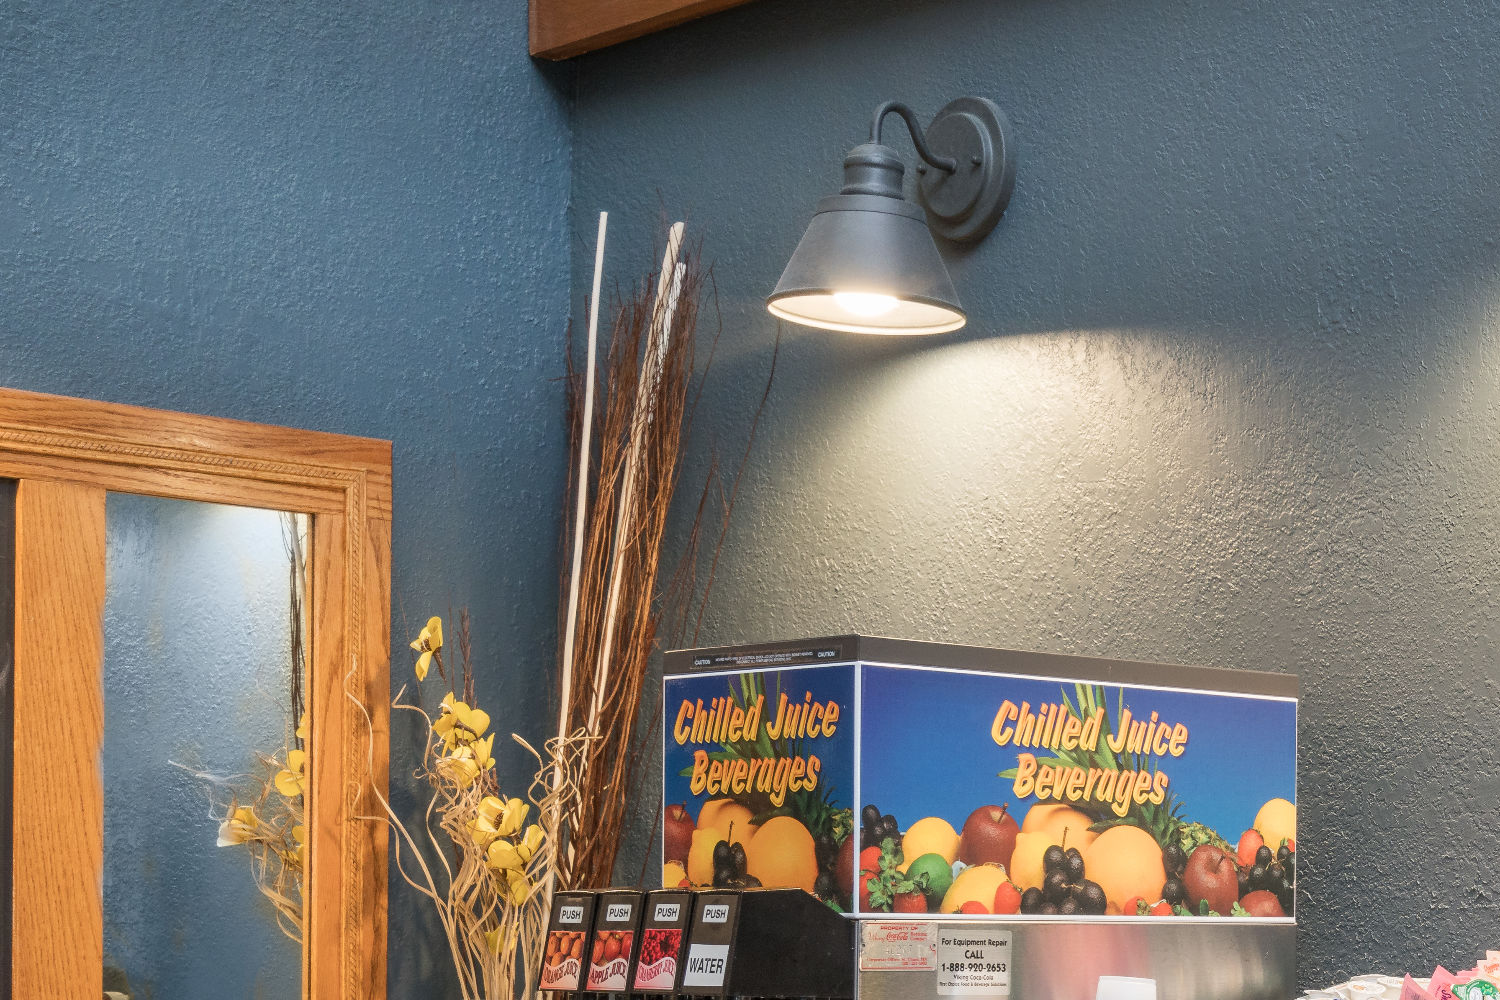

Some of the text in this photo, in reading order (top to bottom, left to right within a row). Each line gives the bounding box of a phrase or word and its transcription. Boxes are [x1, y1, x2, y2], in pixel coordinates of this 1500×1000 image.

[673, 690, 840, 745] Chilled Juice
[991, 699, 1188, 757] Chilled Juice
[690, 750, 821, 807] Beverages
[1012, 753, 1169, 817] Beverages
[561, 909, 581, 919] PUSH
[609, 908, 629, 918] PUSH
[656, 907, 678, 918] PUSH
[705, 909, 726, 919] PUSH
[953, 939, 986, 947] Equipment
[988, 939, 1008, 947] Repair
[965, 950, 984, 959] CALL
[689, 958, 724, 974] WATER
[942, 963, 1007, 972] 1-888-920-2653
[590, 966, 610, 985] APPLE
